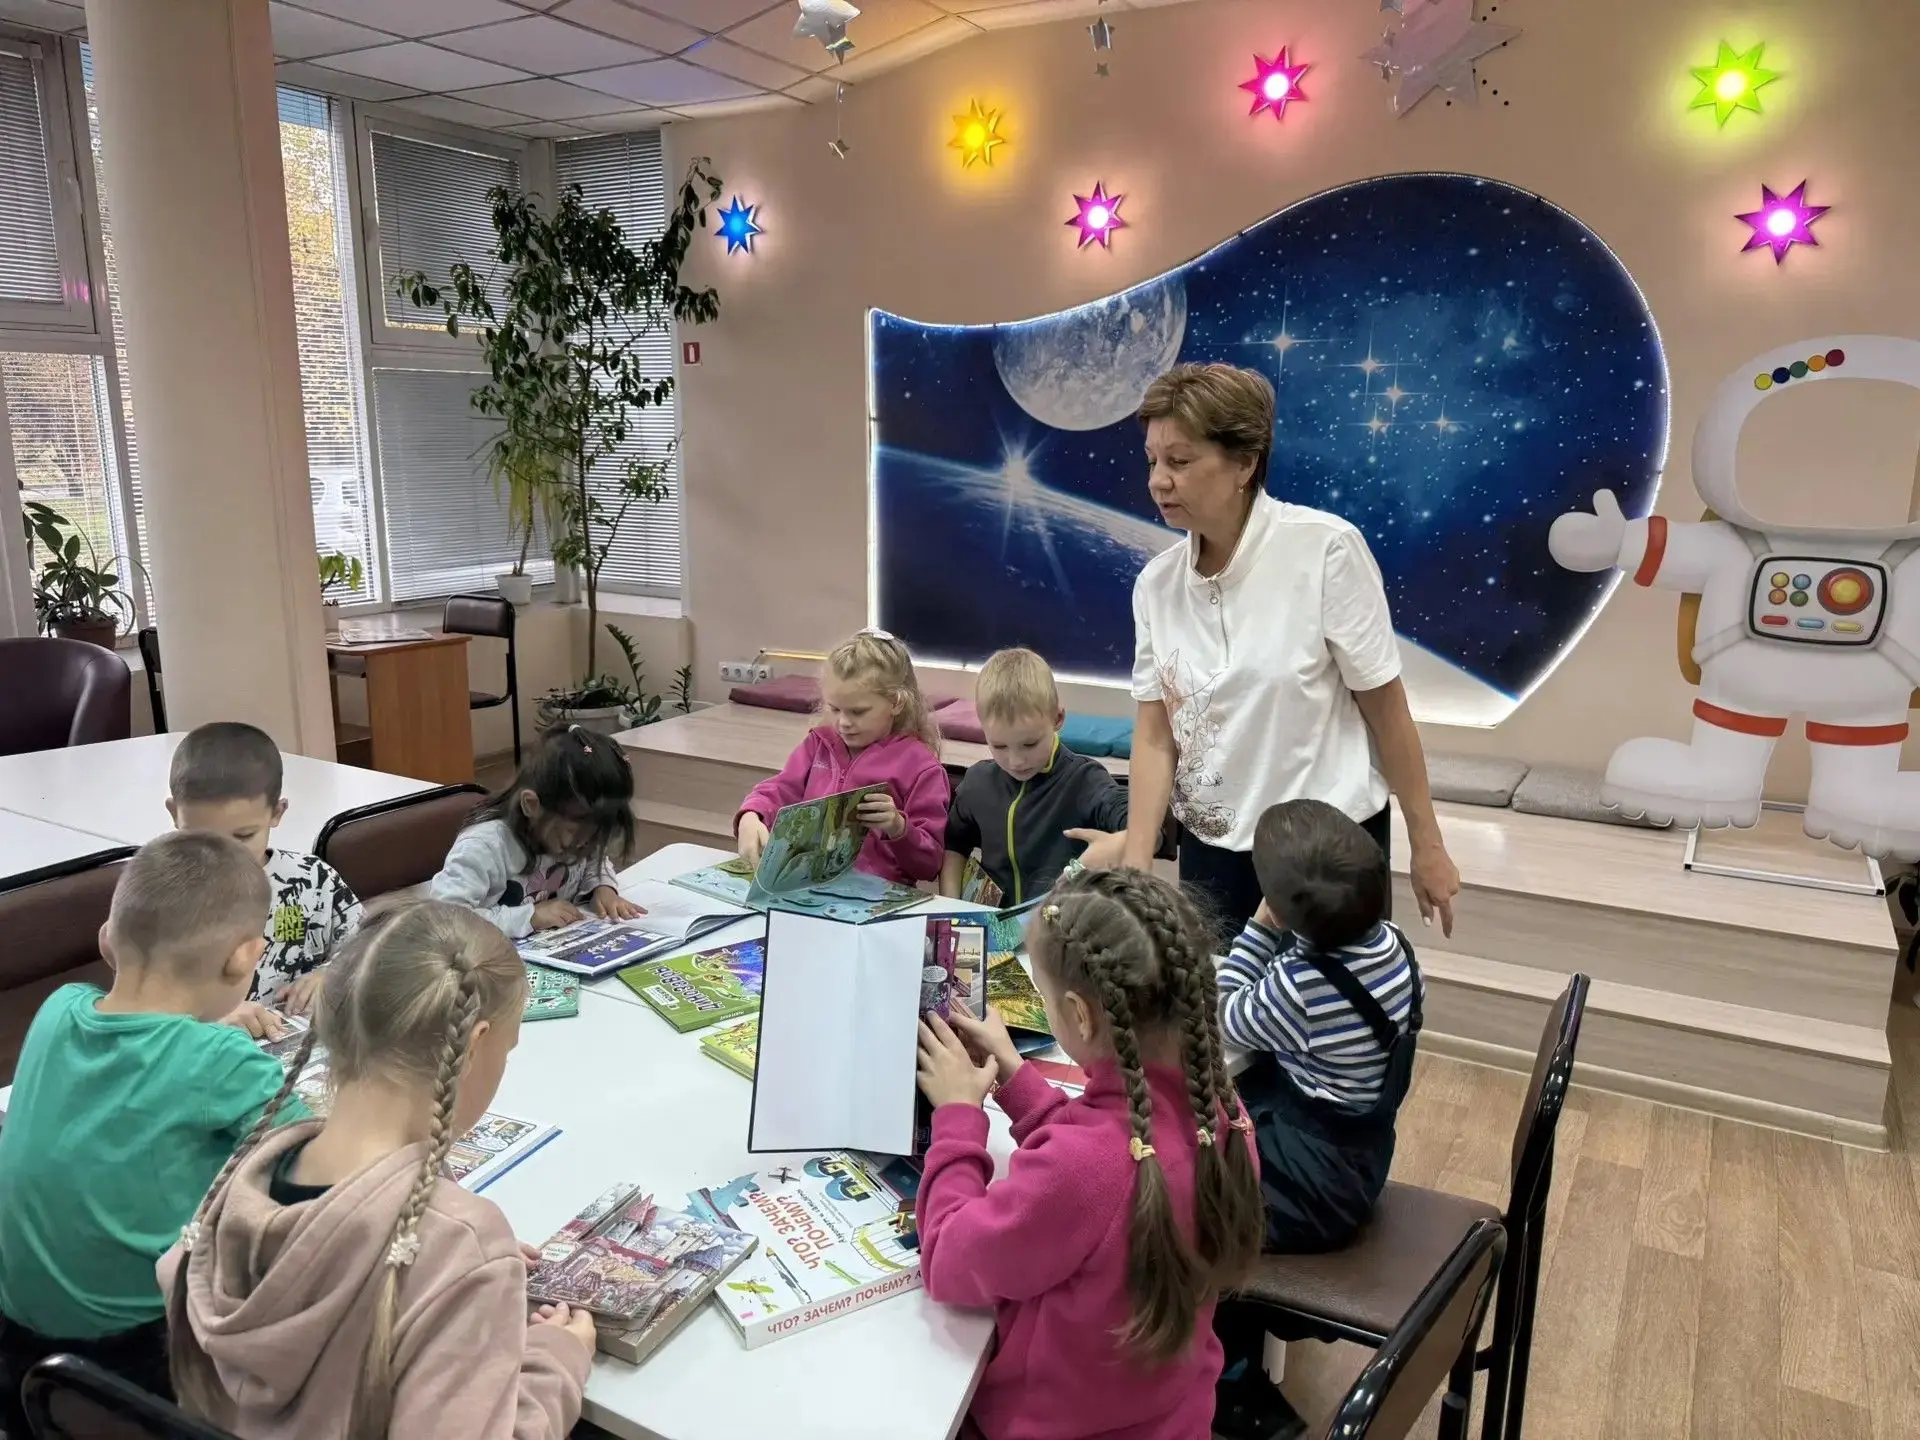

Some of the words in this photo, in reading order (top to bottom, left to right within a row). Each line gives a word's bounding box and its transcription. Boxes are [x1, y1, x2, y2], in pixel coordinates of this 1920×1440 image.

[749, 1191, 796, 1235] ЗАЧЕМ?
[776, 1195, 835, 1250] ПОЧЕМУ?
[787, 1236, 821, 1270] ЧТО?
[767, 1315, 800, 1334] ЧТО?
[803, 1296, 852, 1323] ЗАЧЕМ?
[855, 1274, 912, 1304] ПОЧЕМУ?
